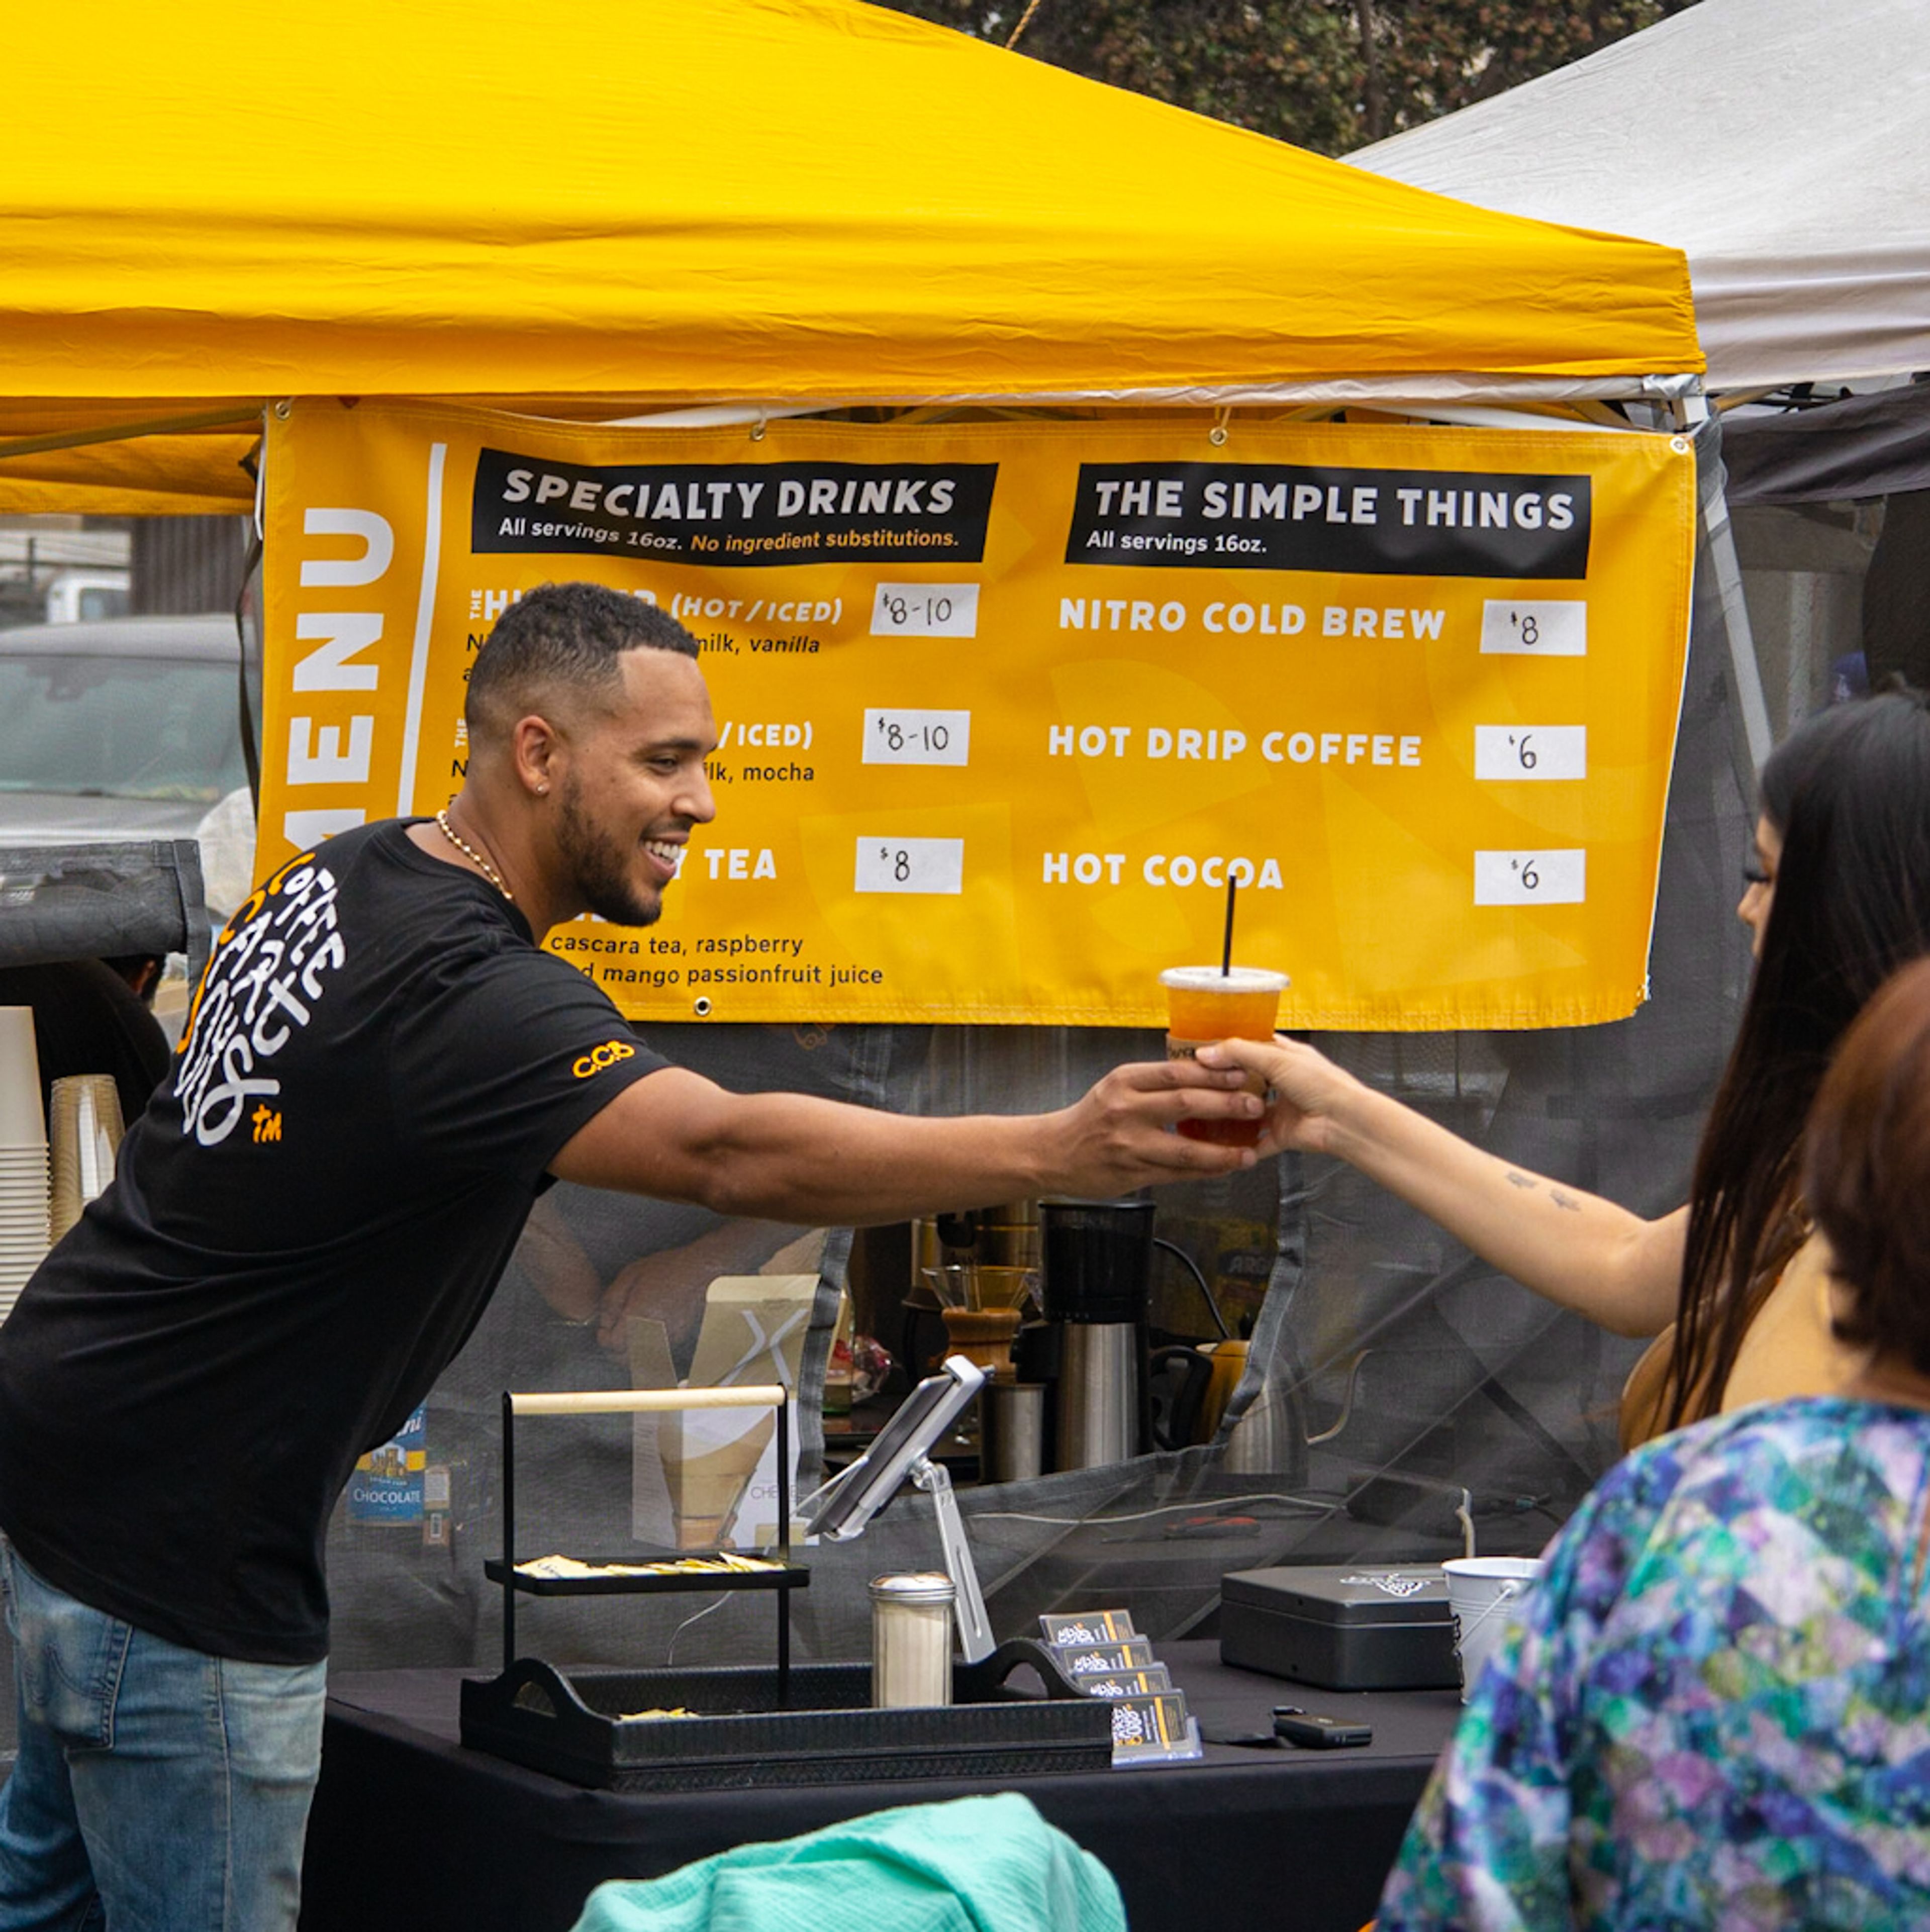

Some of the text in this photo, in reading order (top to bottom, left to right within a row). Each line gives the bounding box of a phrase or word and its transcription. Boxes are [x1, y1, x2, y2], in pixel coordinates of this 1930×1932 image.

[503, 470, 955, 523] SPECIALTY DRINKS
[1096, 480, 1574, 530] THE SIMPLE THINGS
[499, 517, 958, 554] All servings 16oz. No ingredient substitutions.
[1086, 530, 1267, 555] All servings 16oz.
[1060, 598, 1444, 640] NITRO COLD BREW
[750, 635, 820, 653] vanilla
[1049, 725, 1421, 766] HOT DRIP COFFEE
[743, 762, 814, 781] mocha
[704, 849, 776, 879] TEA
[1043, 852, 1283, 889] HOT COCOA
[551, 935, 803, 957] cascara tea, raspberry
[603, 968, 680, 988] mango
[688, 964, 821, 986] passionfruit
[830, 965, 883, 987] juice
